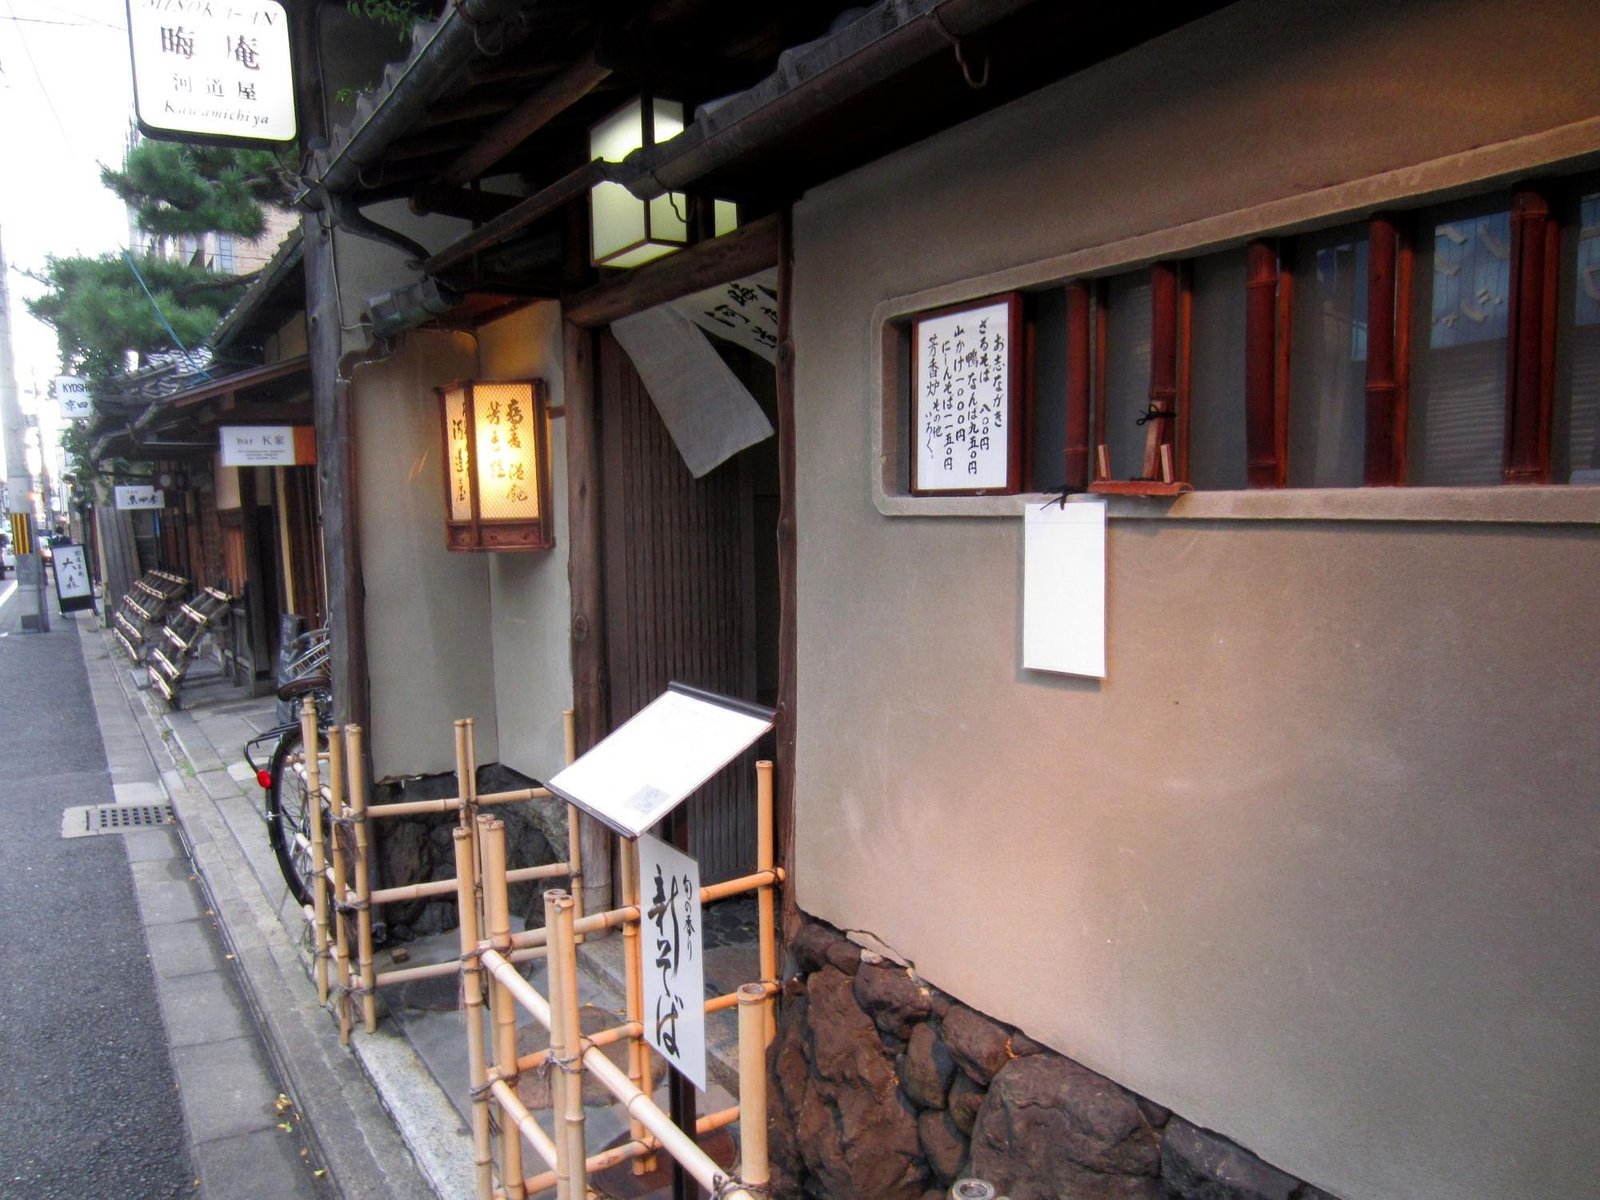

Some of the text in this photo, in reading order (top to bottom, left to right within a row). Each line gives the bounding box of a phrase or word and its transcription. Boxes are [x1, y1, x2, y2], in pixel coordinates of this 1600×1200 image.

[173, 73, 257, 101] 河道屋
[164, 100, 269, 127] Kawamichiya
